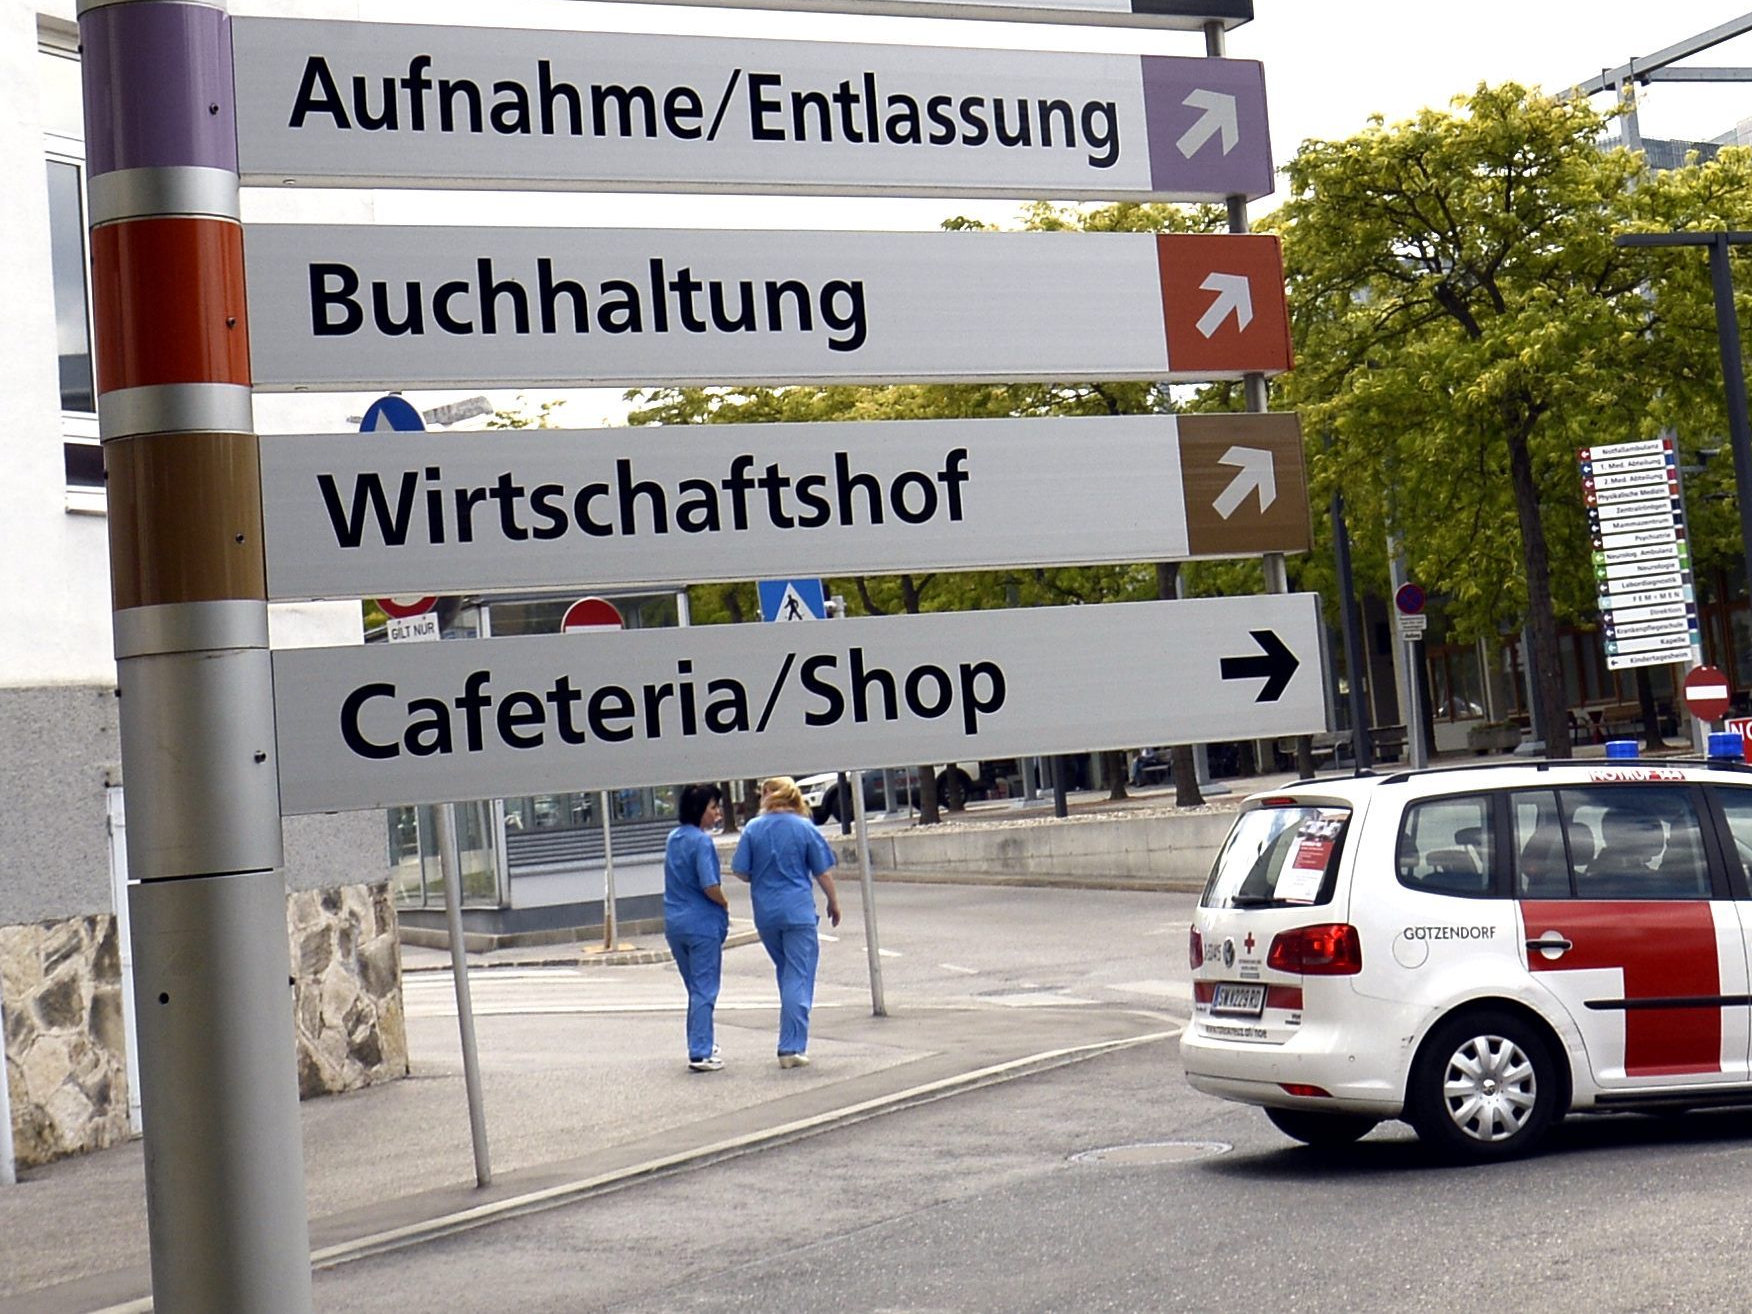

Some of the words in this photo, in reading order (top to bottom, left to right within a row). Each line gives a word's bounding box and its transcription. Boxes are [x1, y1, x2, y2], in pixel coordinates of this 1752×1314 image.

[288, 54, 1120, 169] Aufnahme/Entlassung
[308, 257, 867, 352] Buchhaltung
[1628, 459, 1661, 468] Abteilung
[1630, 473, 1663, 482] Abteilung
[316, 448, 970, 549] Wirtschaftshof
[1637, 562, 1675, 571] Neurologie
[1649, 607, 1682, 616] Direktion
[391, 625, 411, 640] GILT
[413, 622, 435, 636] NUR
[1660, 637, 1686, 646] Kapelle
[1630, 651, 1688, 664] Kindertagesheim
[340, 647, 1006, 760] Cafeteria/Shop
[1403, 925, 1497, 941] GÖTZENDORF
